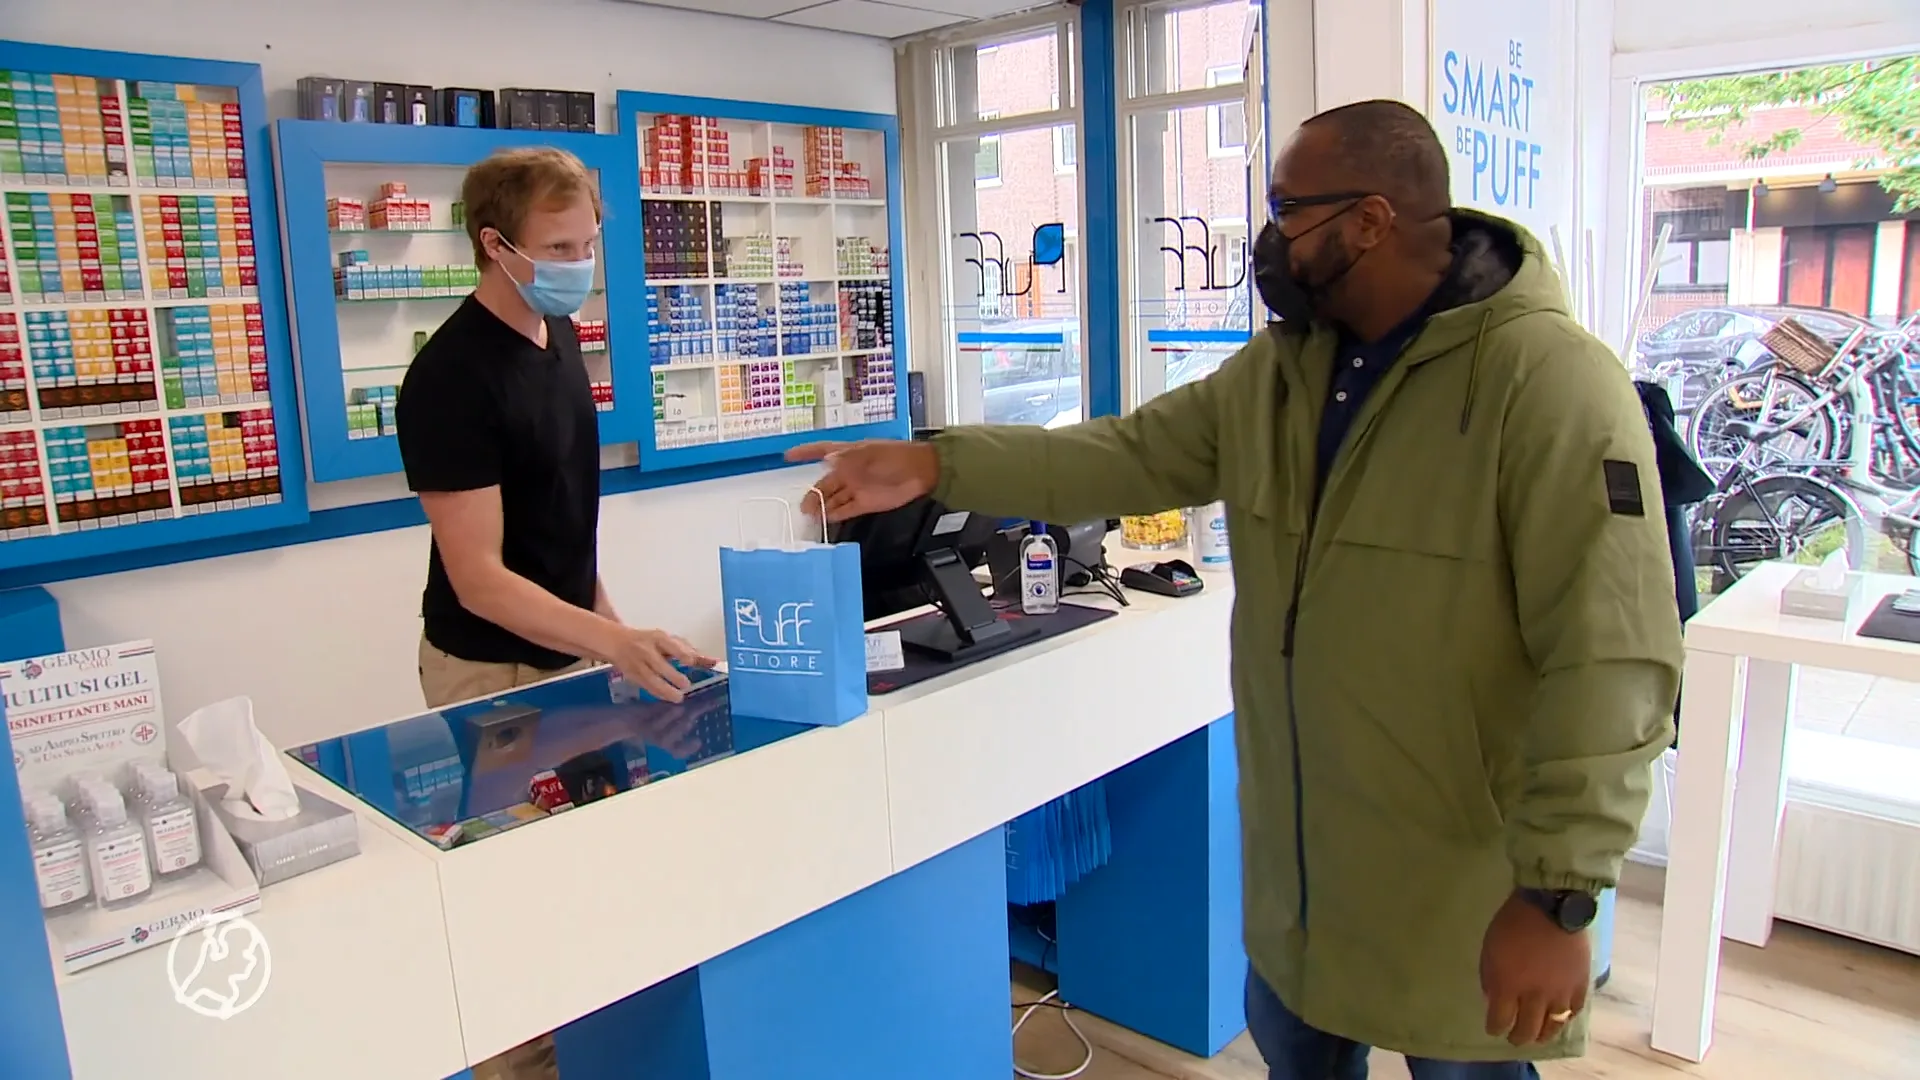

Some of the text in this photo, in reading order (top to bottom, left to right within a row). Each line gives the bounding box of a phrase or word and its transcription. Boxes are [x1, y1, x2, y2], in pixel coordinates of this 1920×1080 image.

[1508, 39, 1522, 69] BE
[1443, 50, 1534, 133] SMART
[1456, 125, 1541, 209] BE PUFF
[42, 648, 111, 670] GERMO
[78, 658, 112, 672] CARE
[737, 653, 816, 670] STORE
[104, 670, 148, 690] GEL
[9, 695, 148, 730] ISINFETTANTE MANI
[149, 908, 205, 932] GERMO
